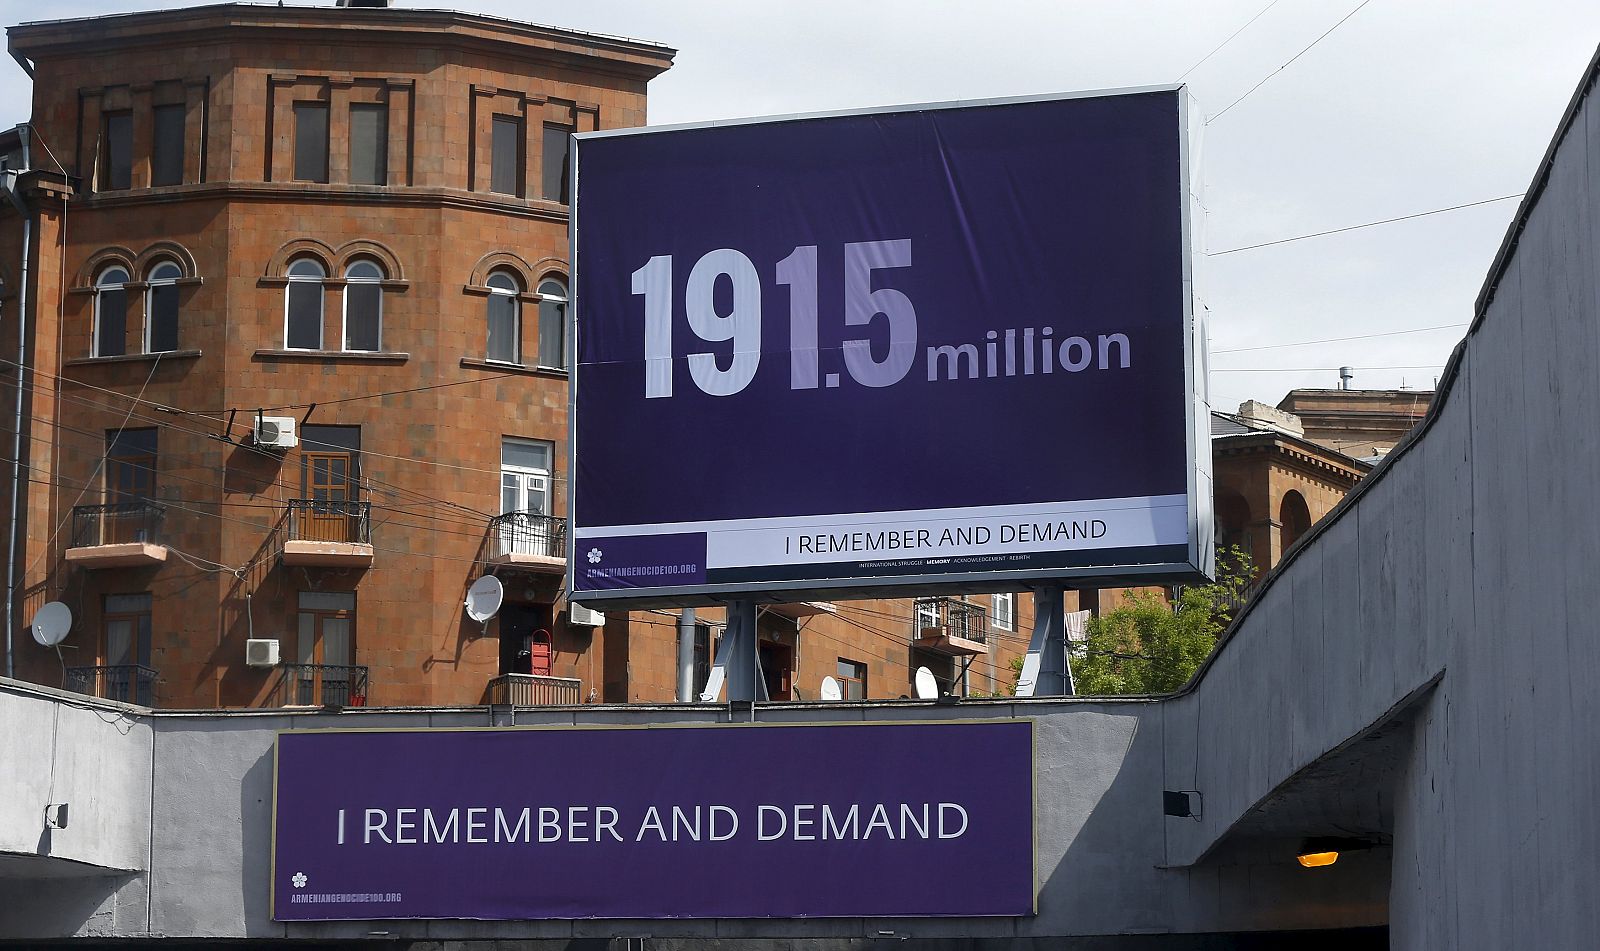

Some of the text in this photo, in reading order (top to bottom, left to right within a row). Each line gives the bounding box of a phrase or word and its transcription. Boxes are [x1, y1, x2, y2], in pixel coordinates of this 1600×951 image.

[927, 326, 1132, 382] million
[785, 519, 1107, 555] I REMEMBER AND DEMAND
[587, 564, 697, 578] ARMENIANGENOCIDE100.ORG
[337, 802, 969, 845] I REMEMBER AND DEMAND
[291, 892, 402, 904] ARMENIANGENOCIDE100.ORG
